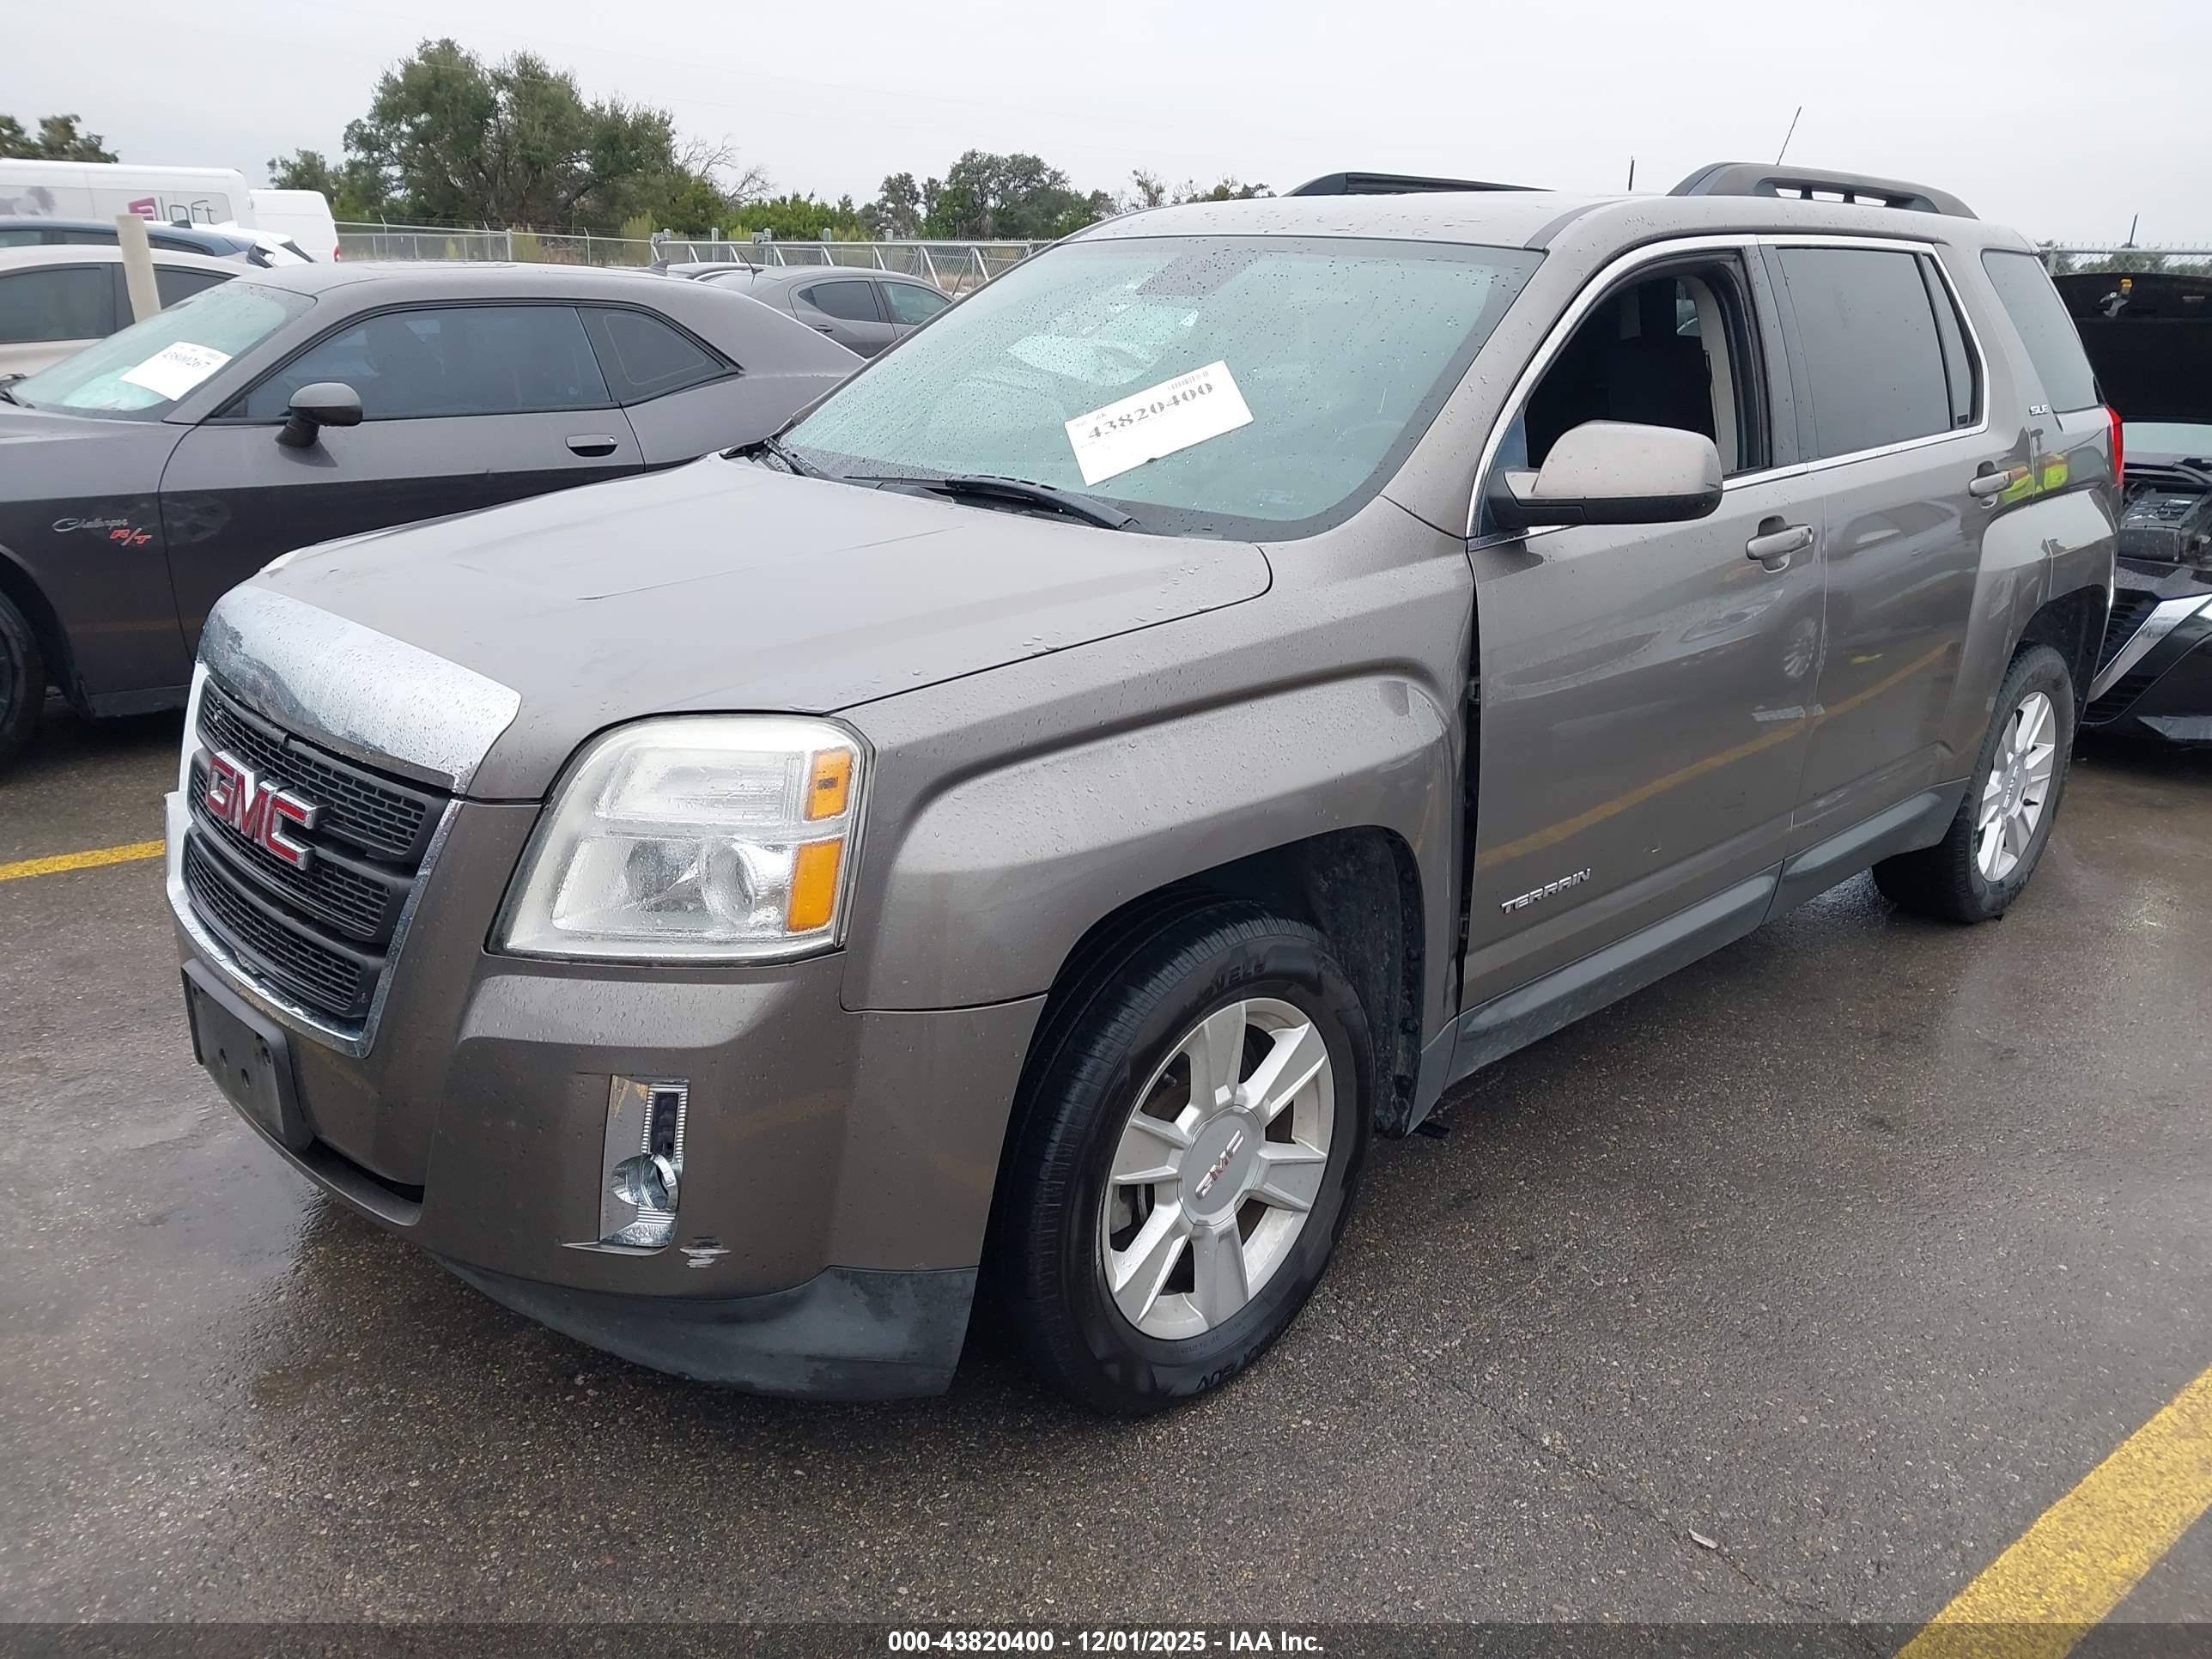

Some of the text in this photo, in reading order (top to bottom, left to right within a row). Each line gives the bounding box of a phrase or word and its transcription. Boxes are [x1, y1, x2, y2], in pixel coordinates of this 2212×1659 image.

[1088, 382, 1214, 439] 43820400
[109, 527, 152, 546] R/T
[205, 749, 318, 872] GMC
[1500, 867, 1591, 915] TERRAIN
[1194, 1128, 1244, 1201] GMC
